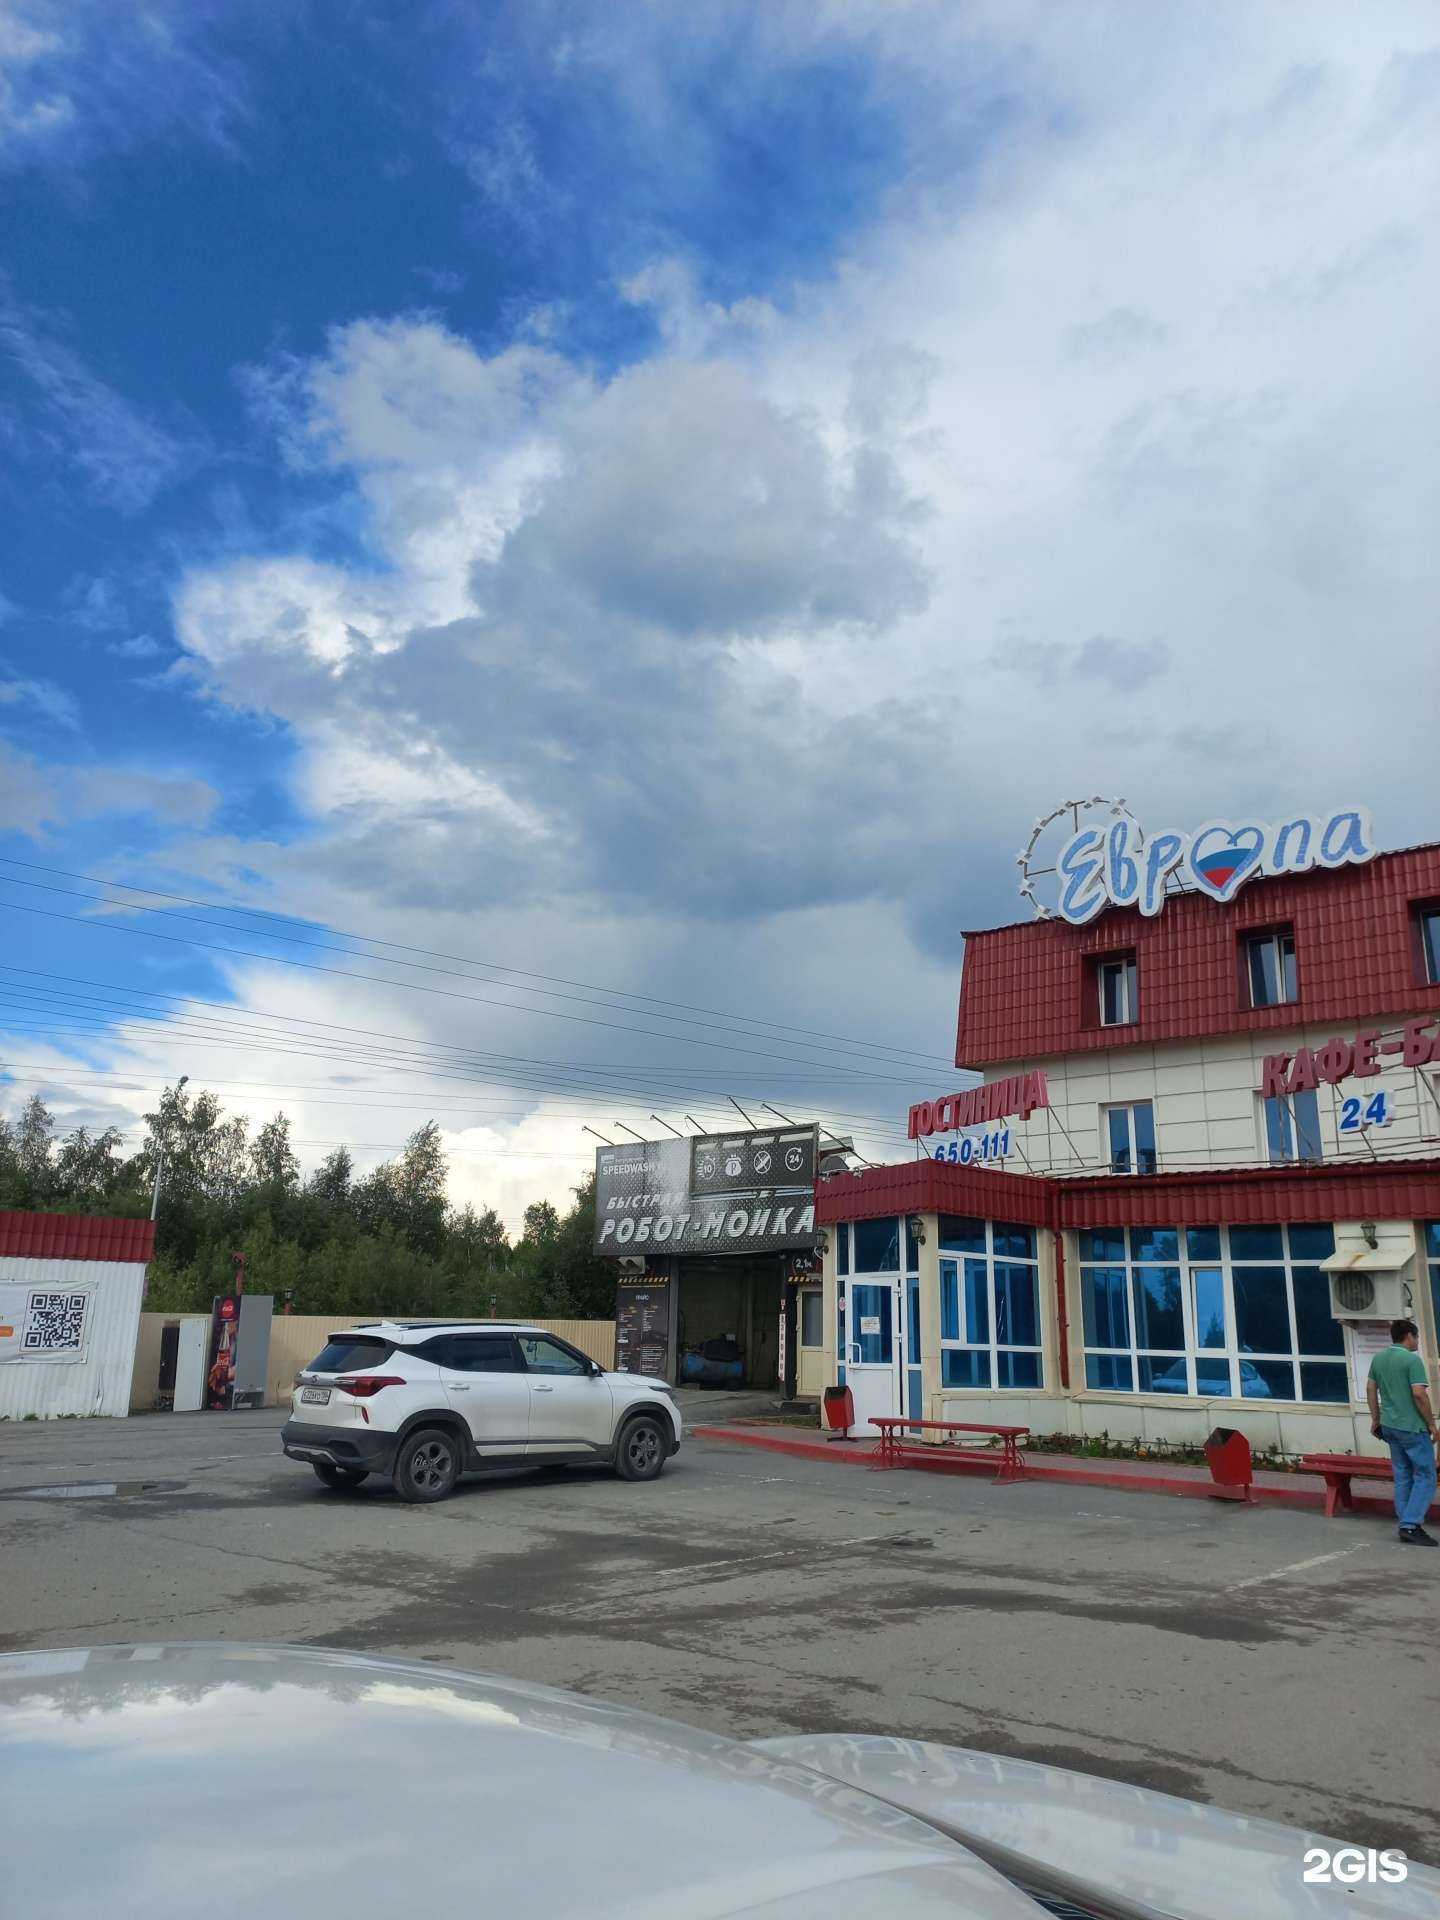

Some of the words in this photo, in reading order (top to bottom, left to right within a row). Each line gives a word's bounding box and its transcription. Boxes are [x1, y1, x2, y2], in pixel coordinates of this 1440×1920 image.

[908, 1069, 1049, 1139] ГОСТИНИЦА
[1340, 1092, 1387, 1130] 24
[935, 1129, 1009, 1163] 650-111
[606, 1191, 685, 1210] БЫСТР
